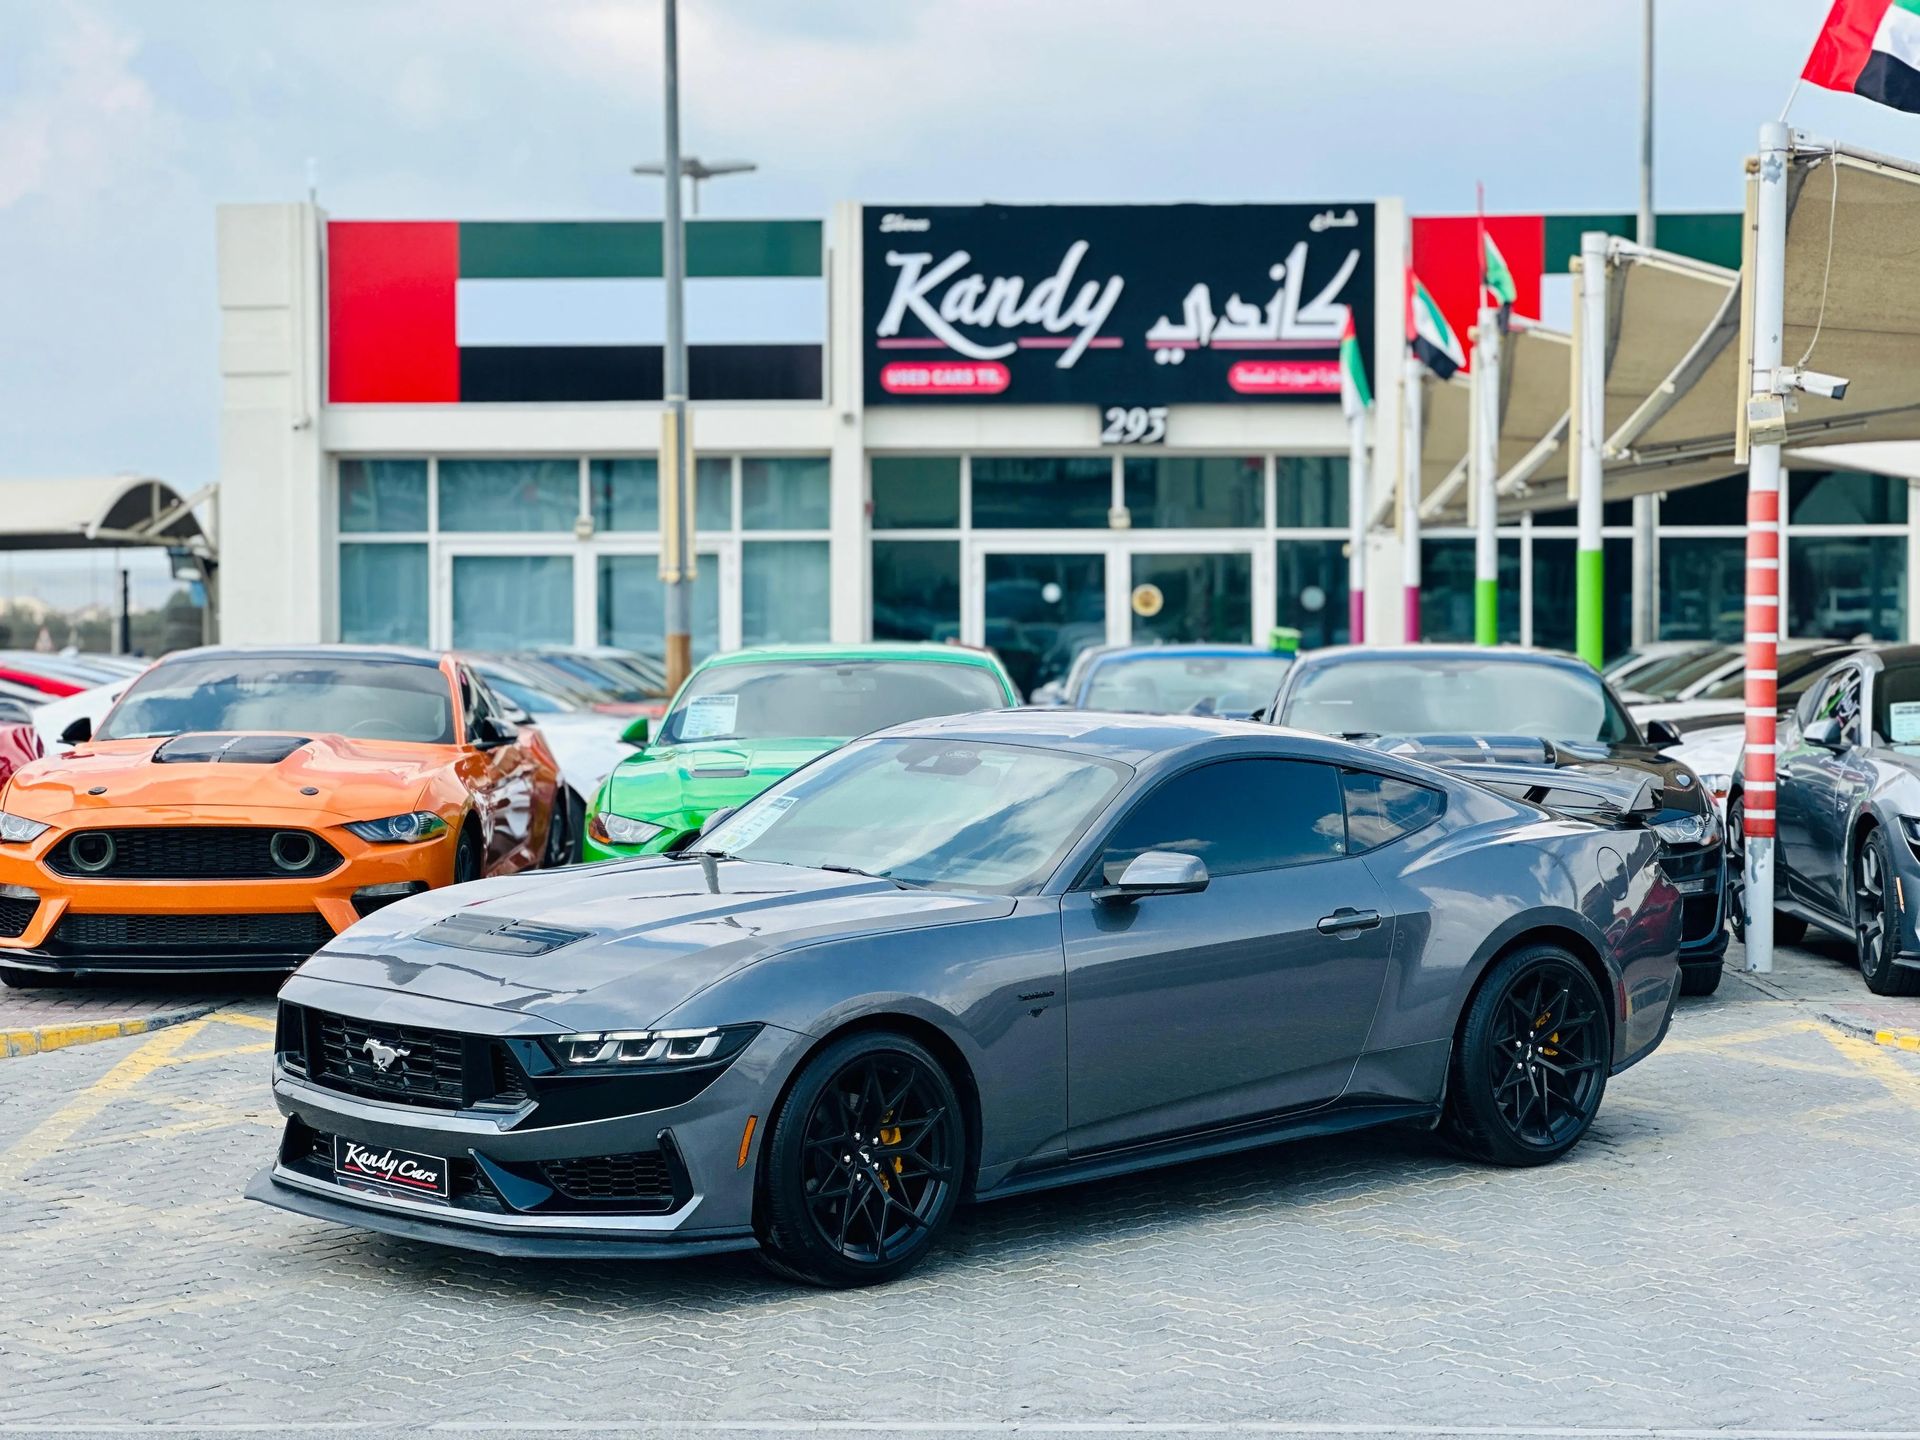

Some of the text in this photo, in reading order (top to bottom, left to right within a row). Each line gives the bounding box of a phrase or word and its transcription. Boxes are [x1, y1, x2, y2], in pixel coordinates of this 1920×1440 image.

[876, 239, 1124, 369] Kandy
[1145, 241, 1360, 365] كاندي
[886, 368, 930, 386] USED
[931, 368, 975, 386] CARS
[1102, 406, 1168, 443] 295
[344, 1142, 438, 1182] Kandy Cars
